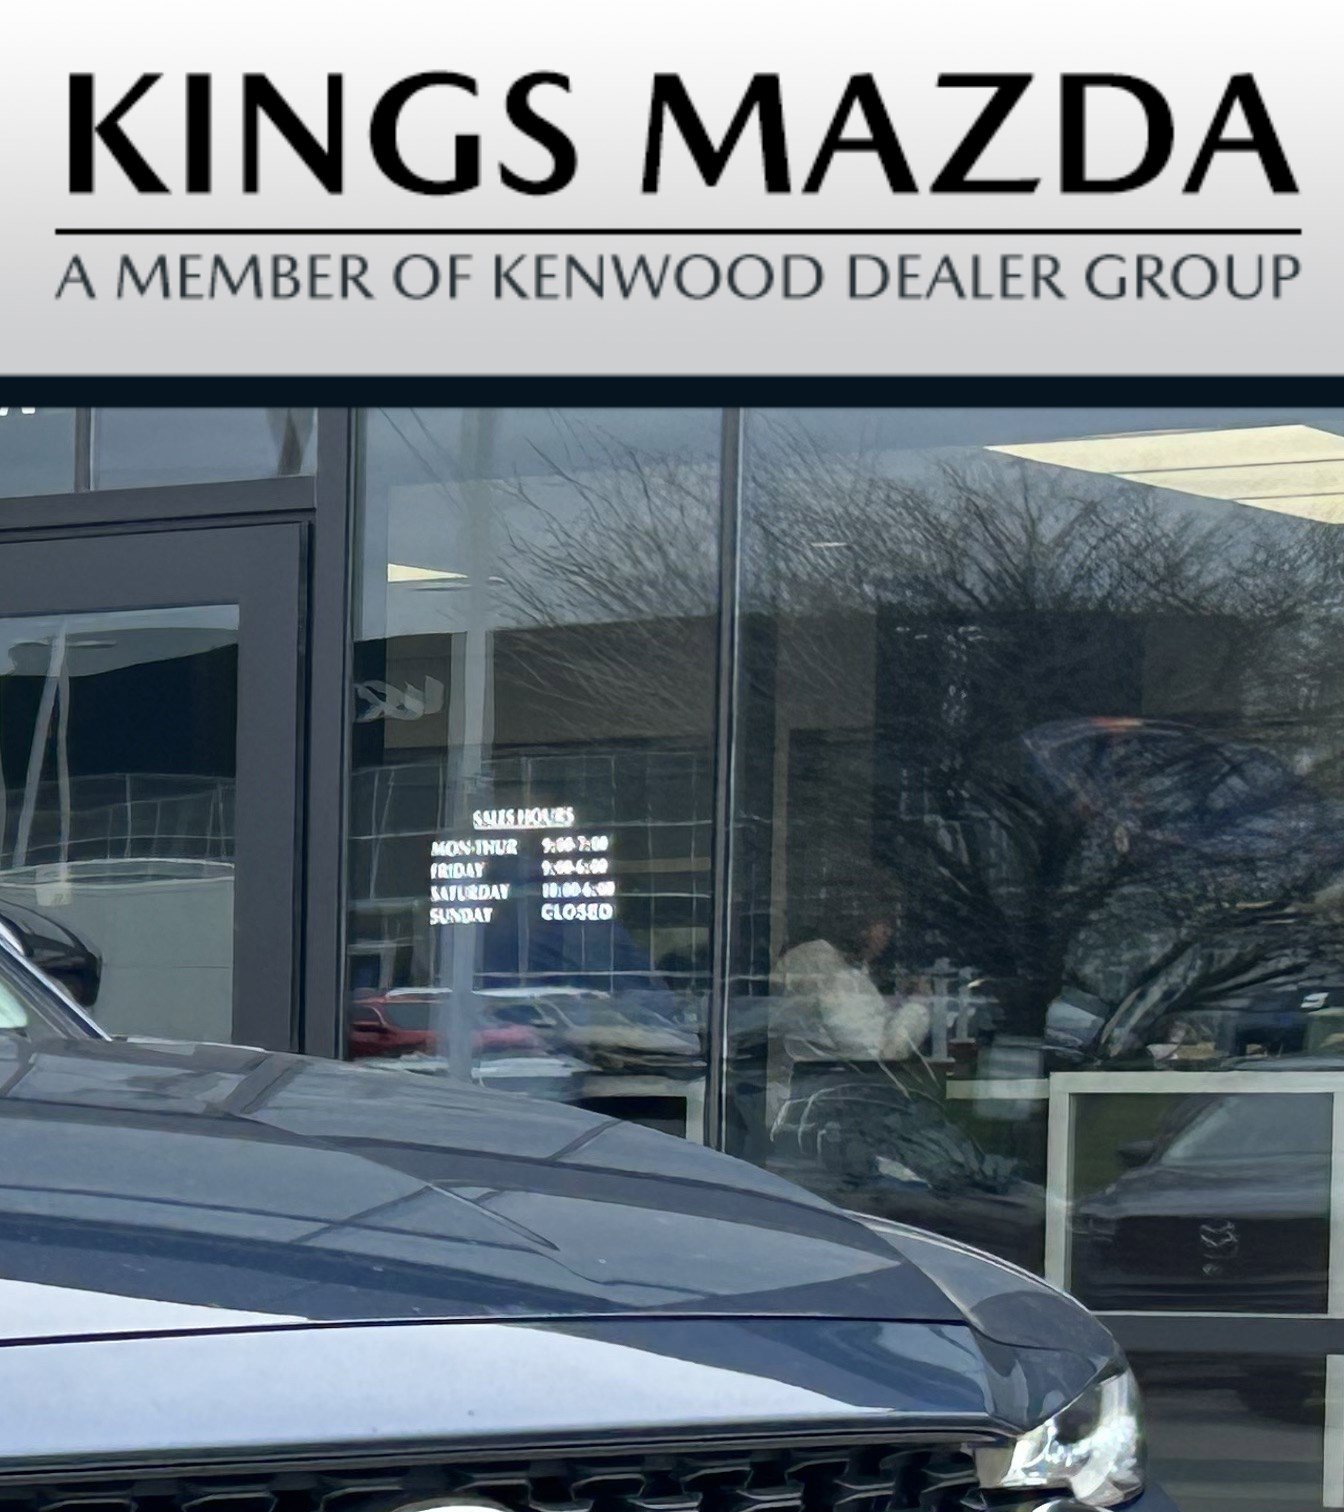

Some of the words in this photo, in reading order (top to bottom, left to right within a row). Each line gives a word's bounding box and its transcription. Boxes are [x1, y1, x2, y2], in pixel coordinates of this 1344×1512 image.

[517, 806, 575, 827] HOURS
[430, 861, 486, 880] FRIDAY
[430, 883, 511, 902] SATURDAY
[429, 907, 494, 925] SUNDAY
[541, 903, 614, 921] CLOSED
